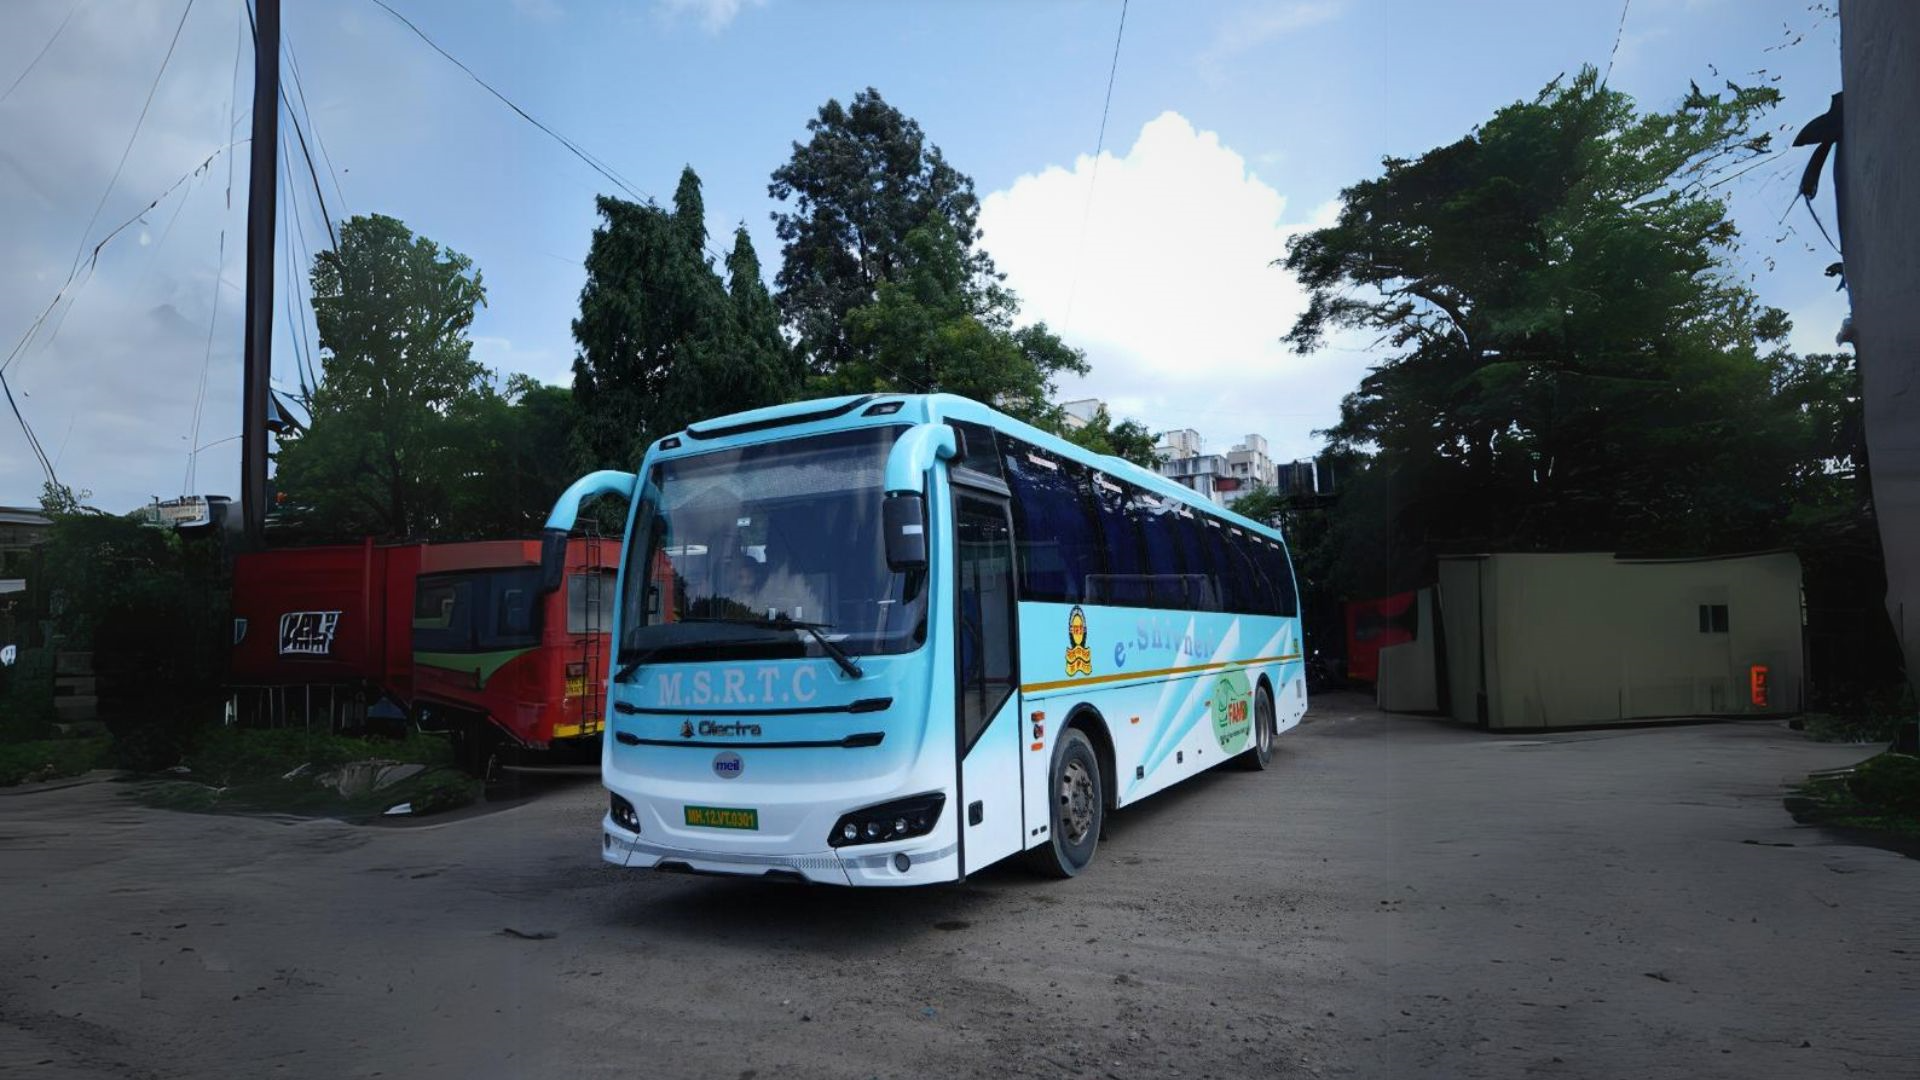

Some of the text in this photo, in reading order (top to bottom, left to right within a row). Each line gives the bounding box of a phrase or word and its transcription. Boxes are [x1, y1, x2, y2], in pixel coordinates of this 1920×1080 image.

[658, 665, 817, 706] M.S.R.T.C
[698, 720, 762, 737] Olectra
[716, 759, 740, 771] meil
